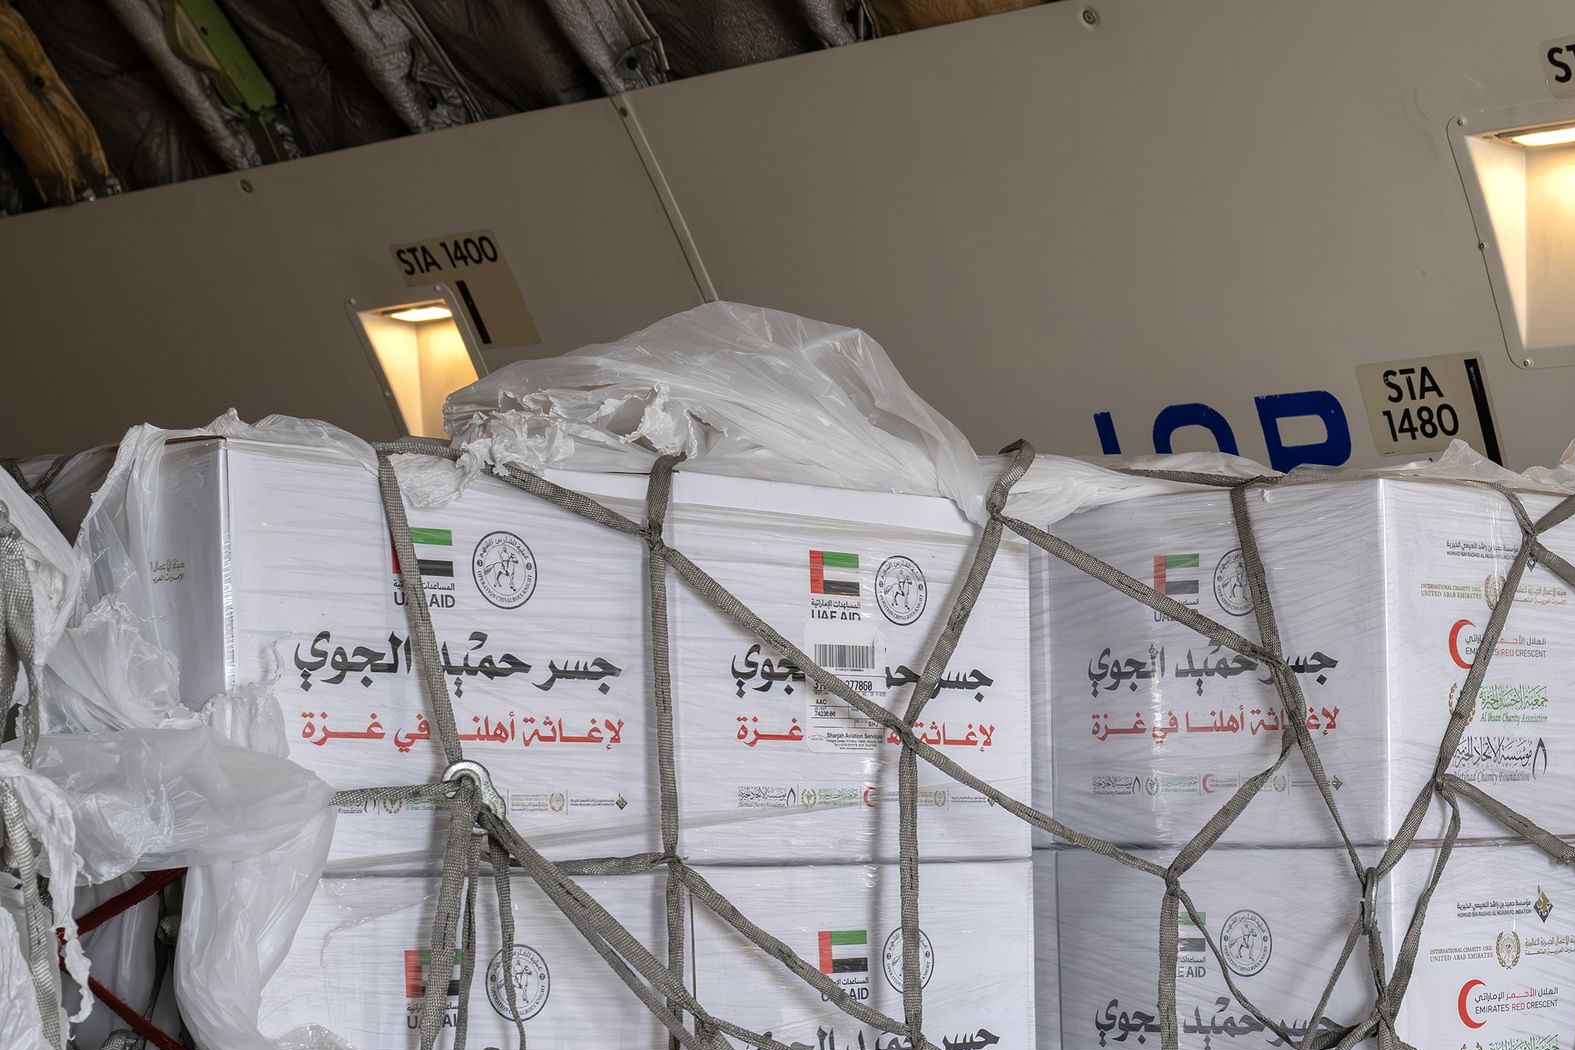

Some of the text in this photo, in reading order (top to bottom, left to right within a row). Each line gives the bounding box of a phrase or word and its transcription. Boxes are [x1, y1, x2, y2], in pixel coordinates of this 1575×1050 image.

[396, 236, 498, 275] STA 1400
[1382, 367, 1444, 403] STA
[1382, 403, 1459, 442] 1480
[429, 594, 456, 608] AID
[1501, 649, 1546, 658] RED CRESCENT
[1526, 637, 1546, 646] الهلال
[293, 631, 412, 692] الجوي
[531, 652, 622, 695] جسر
[1088, 646, 1165, 698] الجوي
[300, 711, 625, 752] لإغاثة أهلن في غزة
[736, 715, 804, 748] غزة
[1091, 712, 1147, 742] غزة
[1185, 704, 1245, 733] أهلنا
[1468, 952, 1494, 960] EMIRATES
[1186, 966, 1206, 978] AID
[850, 988, 869, 1001] AID
[1474, 987, 1558, 1003] الهلال الأحمر الإماراتي
[1475, 999, 1558, 1014] EMIRATES RED CRESCENT
